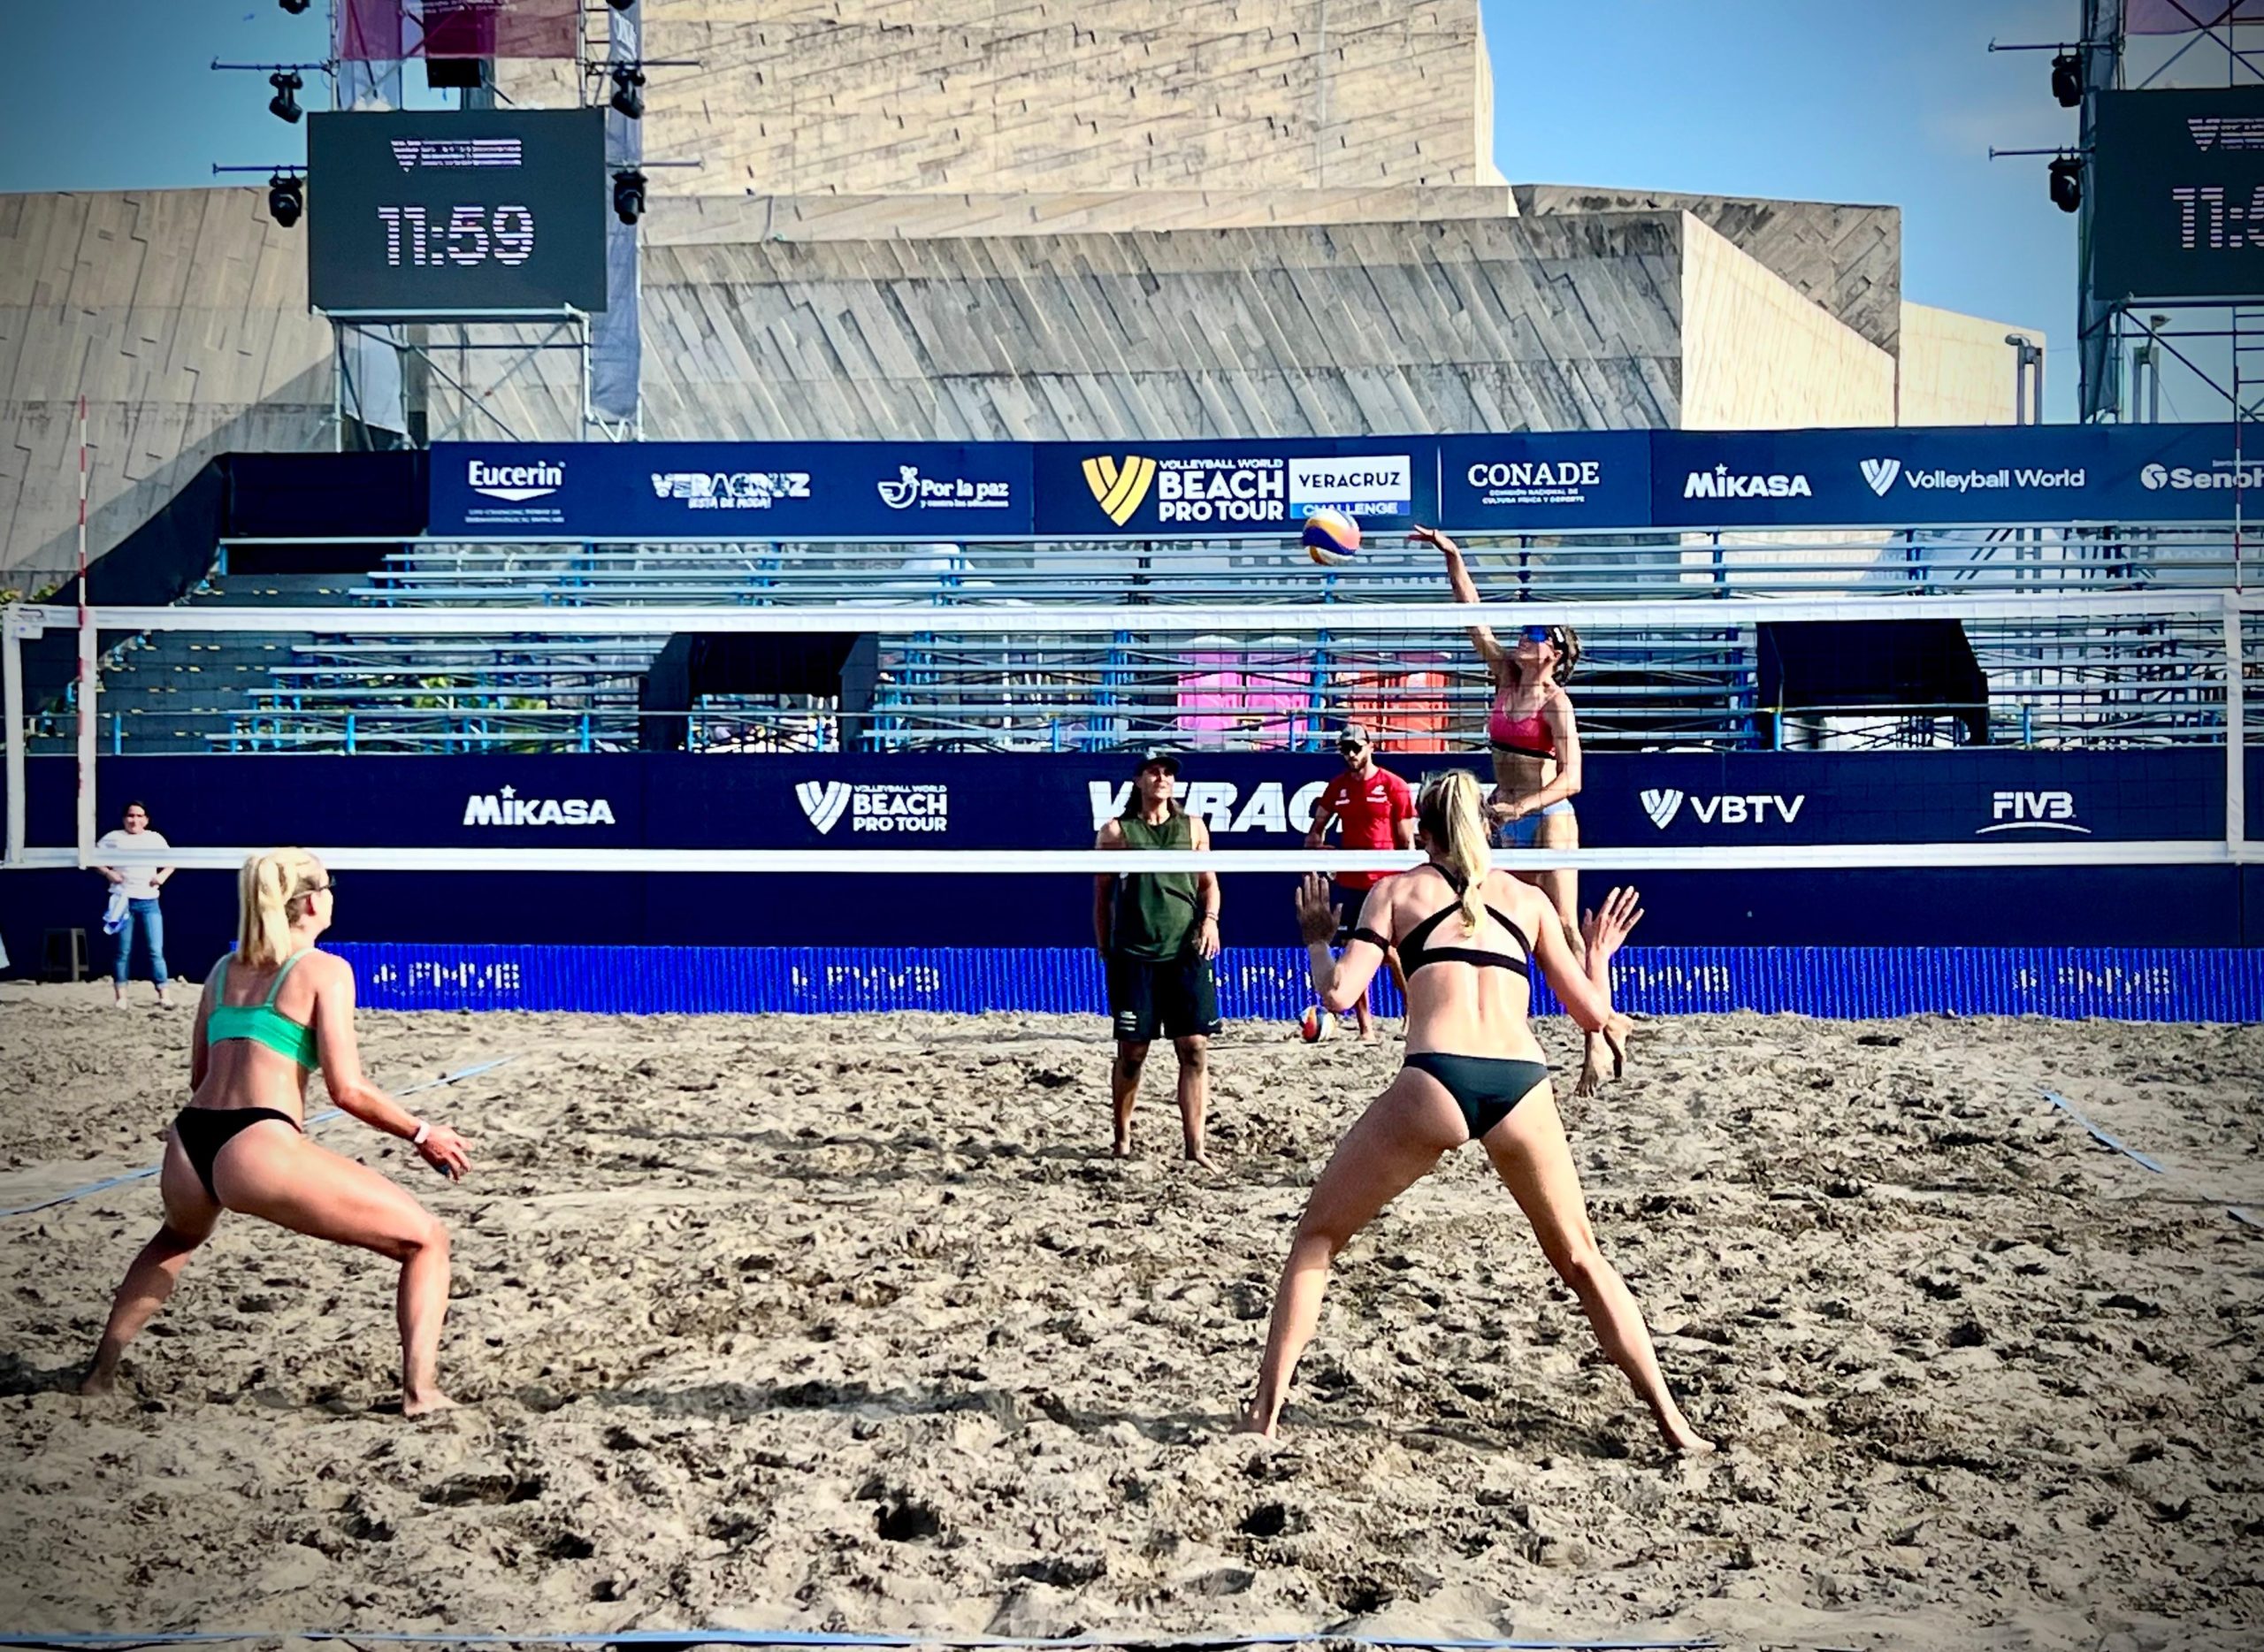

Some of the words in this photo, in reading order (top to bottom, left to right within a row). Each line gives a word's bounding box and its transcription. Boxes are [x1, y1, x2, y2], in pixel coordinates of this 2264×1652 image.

[378, 205, 534, 266] 11:59
[469, 460, 562, 486] Eucerin
[1159, 458, 1236, 470] VOLLEYBALL
[1237, 458, 1283, 469] WORLD
[1468, 462, 1600, 486] CONADE
[651, 472, 810, 498] VERACRUZ
[921, 478, 954, 497] Por
[956, 478, 973, 497] la
[976, 483, 1009, 501] paz
[1159, 470, 1283, 500] BEACH
[1298, 471, 1400, 488] VERACRUZ
[1905, 470, 2009, 493] Volleyball
[2014, 469, 2085, 486] World
[1159, 501, 1212, 522] PRO
[1214, 500, 1283, 521] TOUR
[853, 793, 947, 815] BEACH
[1690, 795, 1805, 823] VBTV
[1993, 792, 2073, 819] FIVB
[853, 817, 893, 831] PRO
[895, 817, 947, 831] TOUR
